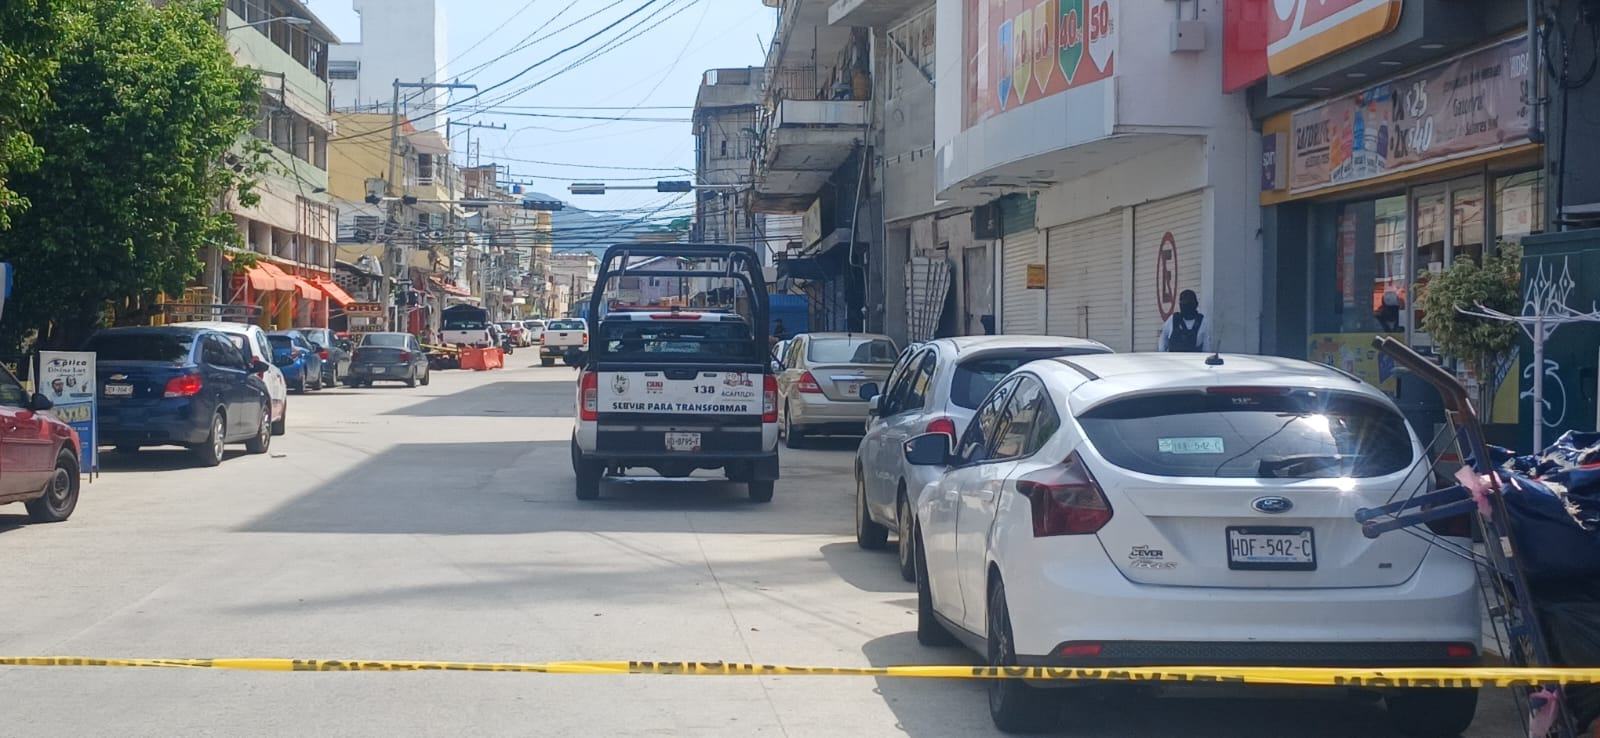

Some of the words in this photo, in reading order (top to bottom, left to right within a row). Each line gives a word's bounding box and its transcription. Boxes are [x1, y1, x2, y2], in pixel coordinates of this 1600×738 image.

[346, 304, 382, 312] ORO
[612, 402, 646, 411] SERVIR
[647, 402, 673, 412] PARA
[676, 403, 748, 412] TRANSFORMAR
[1231, 538, 1311, 557] HDF-542-C
